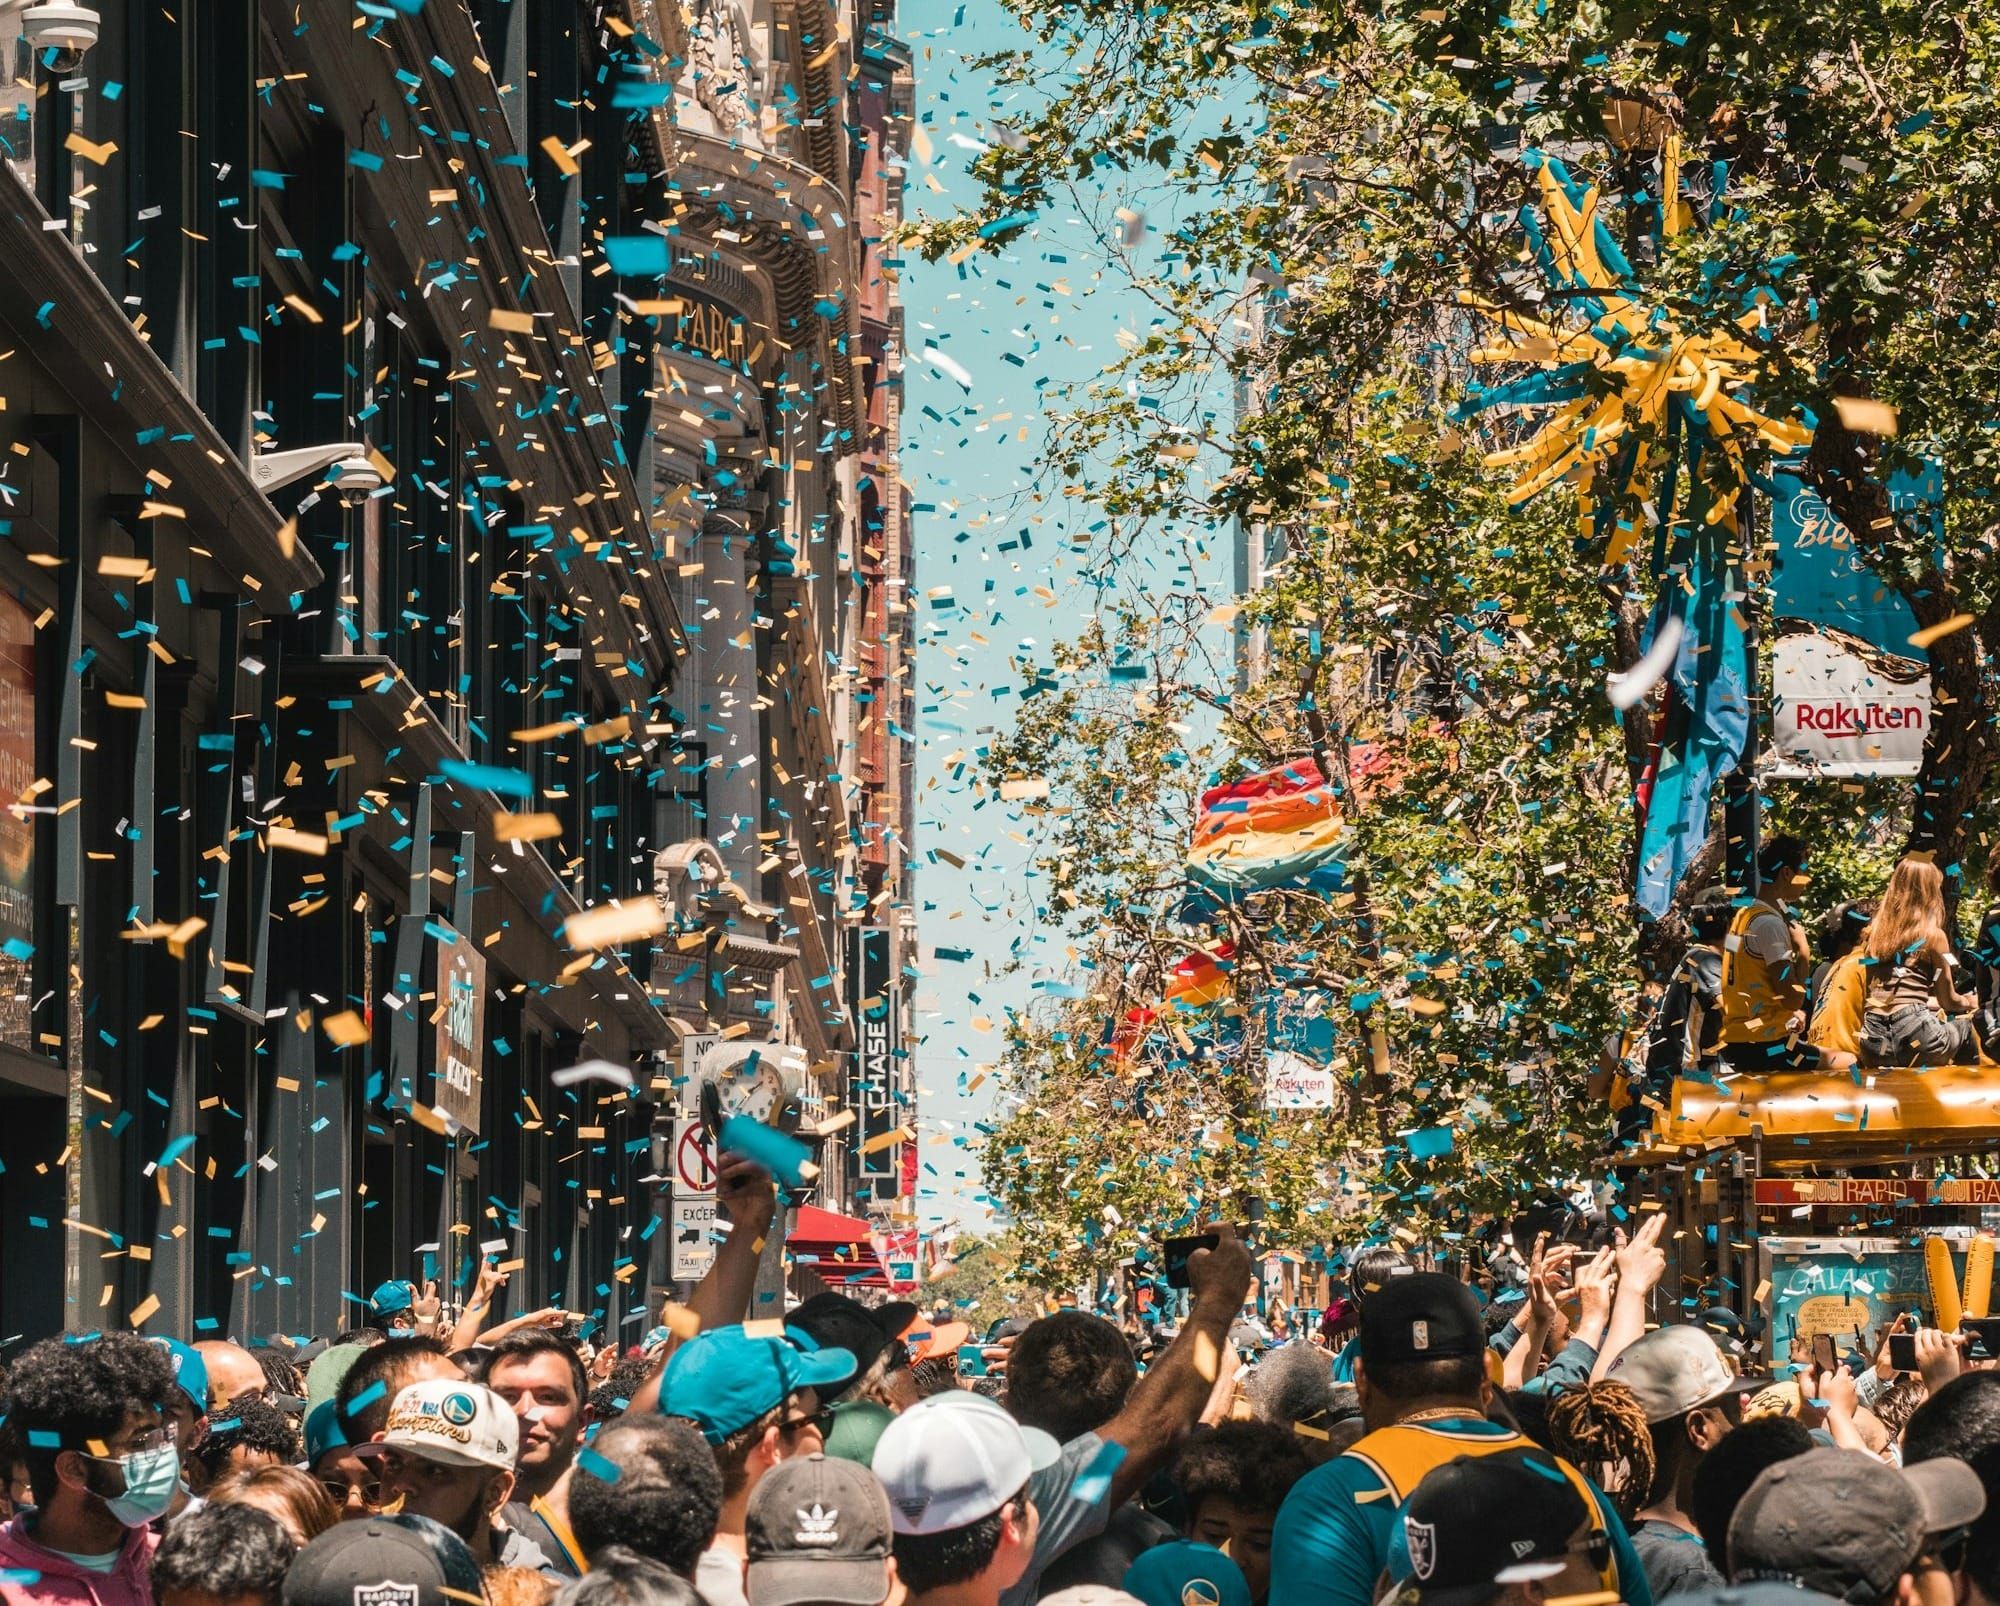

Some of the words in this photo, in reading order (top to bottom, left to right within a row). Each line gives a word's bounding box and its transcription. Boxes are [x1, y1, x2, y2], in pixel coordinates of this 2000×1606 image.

[0, 678, 24, 738] ETAIL
[1796, 702, 1923, 730] Rakuten
[867, 1021, 887, 1109] CHASE
[1275, 1078, 1325, 1090] Rakuten
[1846, 1181, 1907, 1202] RAPID
[683, 1208, 716, 1220] EXCEP
[680, 1258, 697, 1266] TAXI
[421, 1401, 439, 1416] NBA
[795, 1531, 839, 1542] adidas
